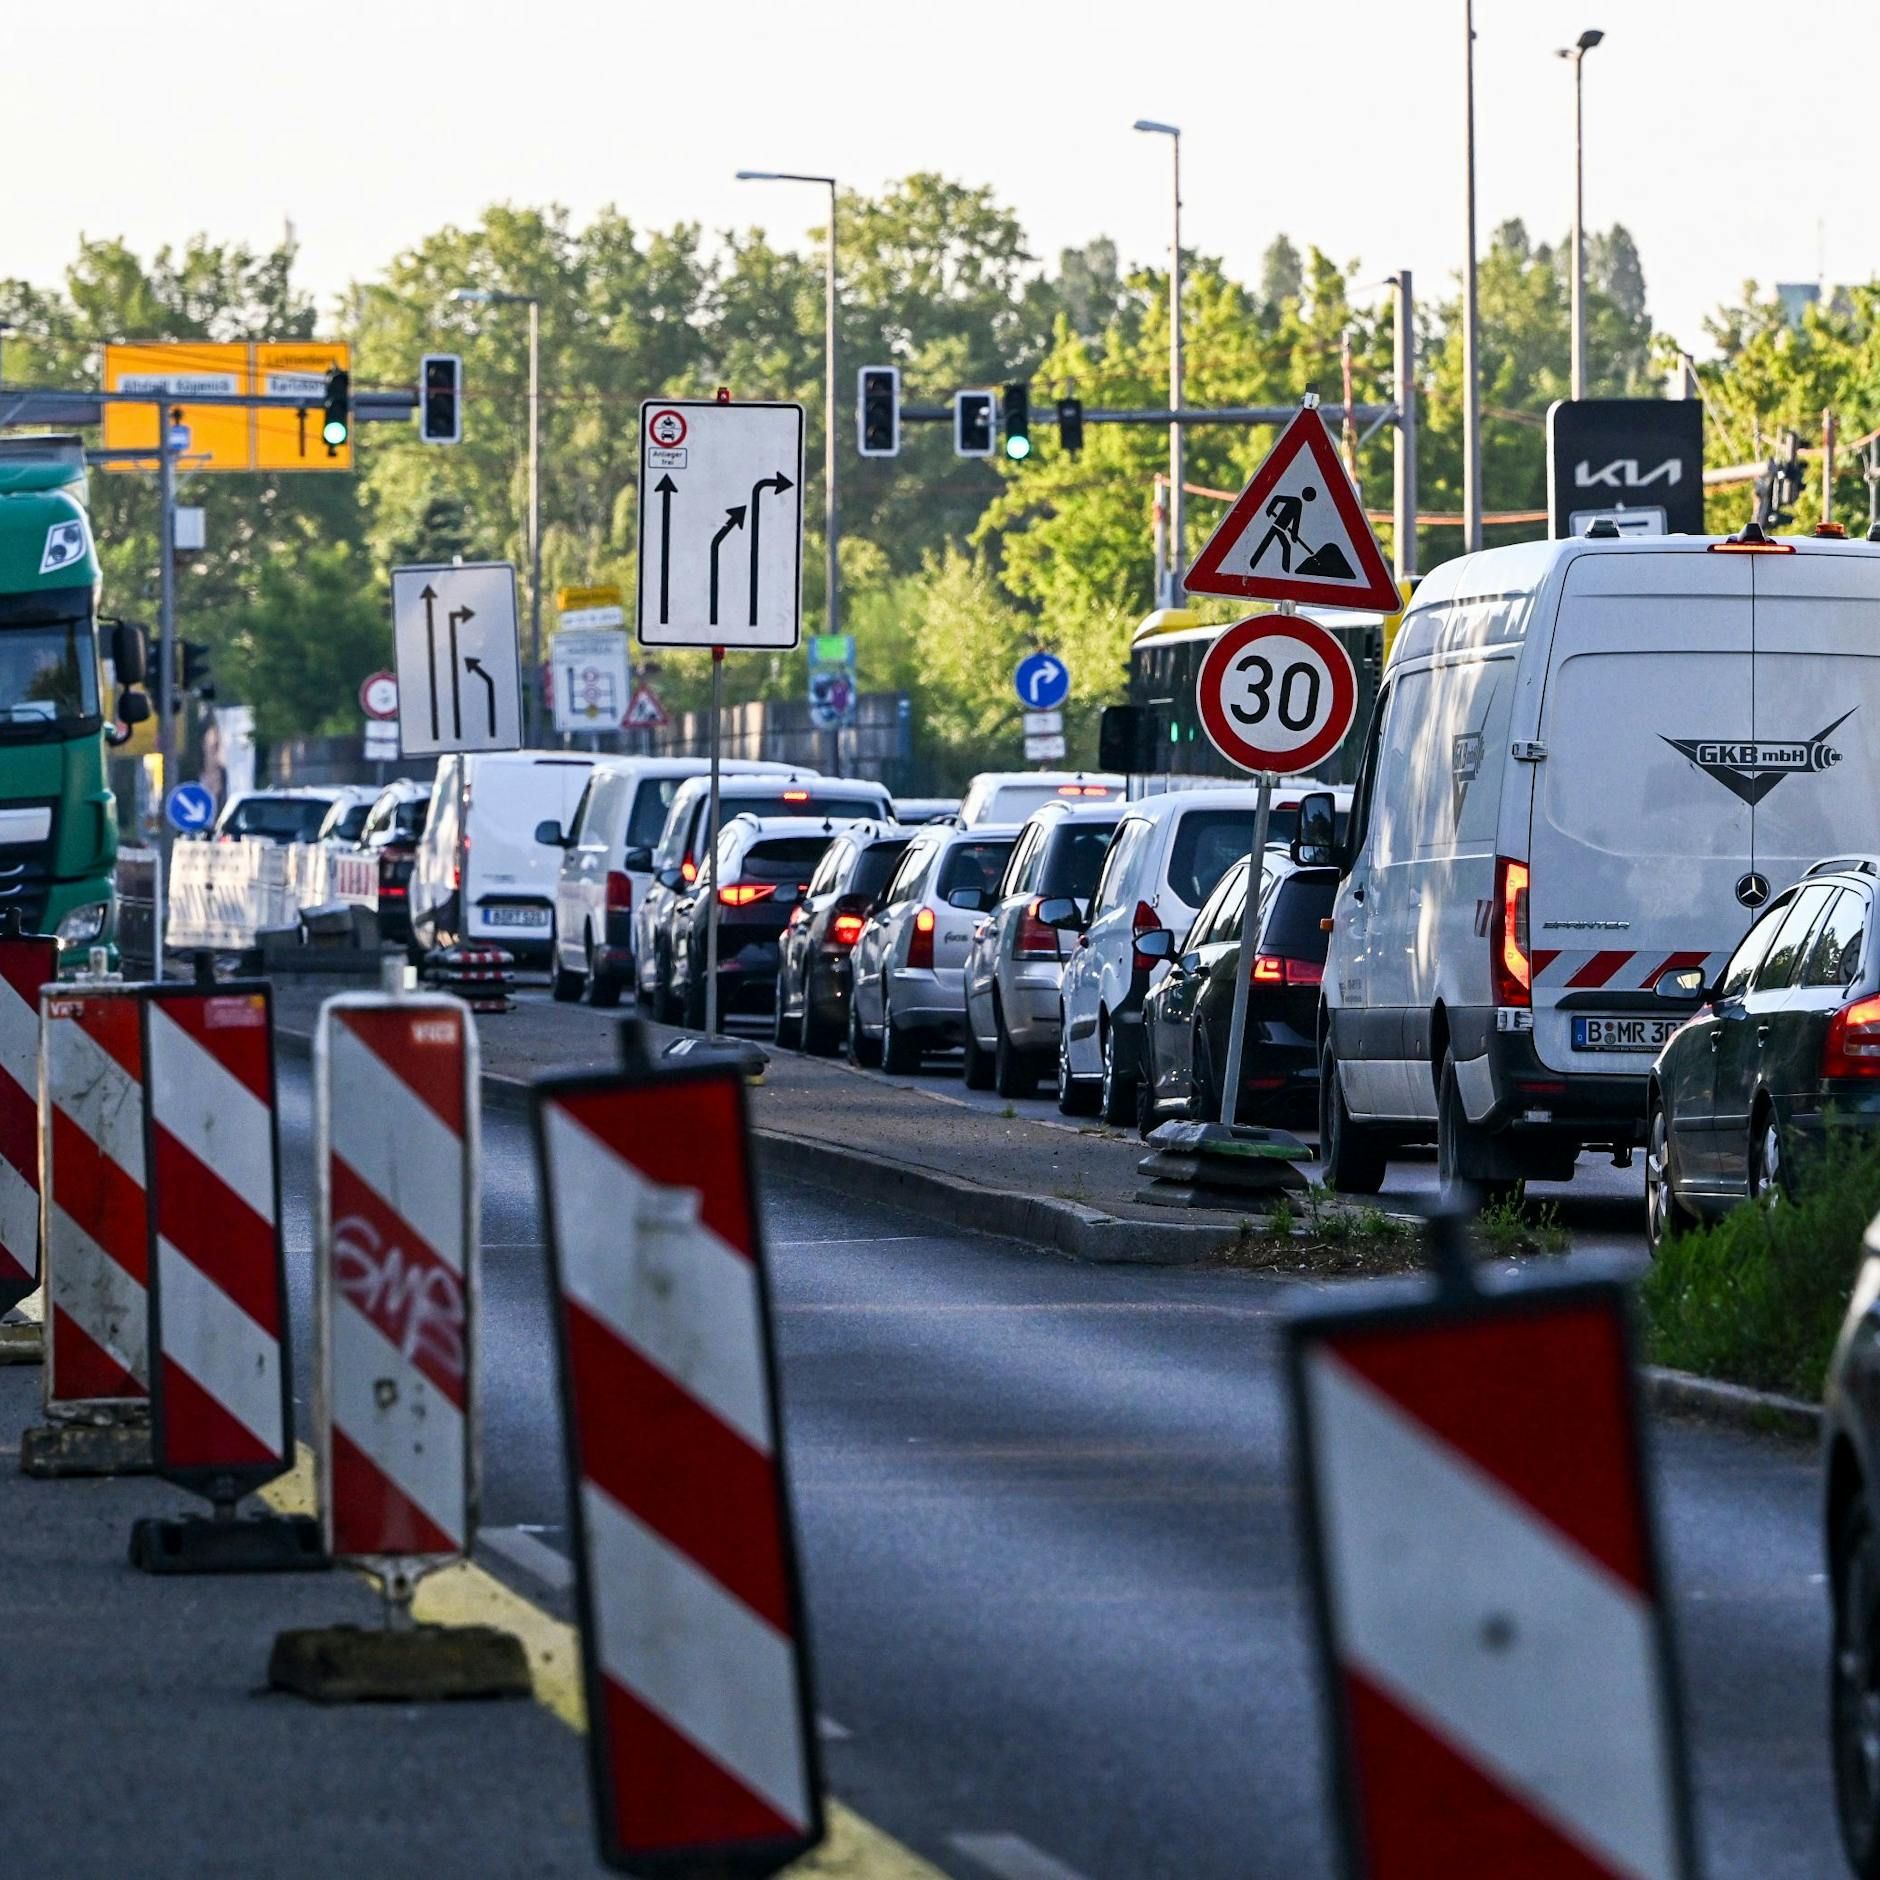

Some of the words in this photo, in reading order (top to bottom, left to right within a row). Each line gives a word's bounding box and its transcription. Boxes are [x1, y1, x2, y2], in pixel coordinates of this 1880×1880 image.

[653, 451, 682, 459] Anlieger
[1575, 459, 1682, 487] KIA
[1230, 655, 1320, 731] 30
[1699, 745, 1758, 764] GKB
[1762, 749, 1804, 762] mbH
[1543, 920, 1630, 930] SPRINTER
